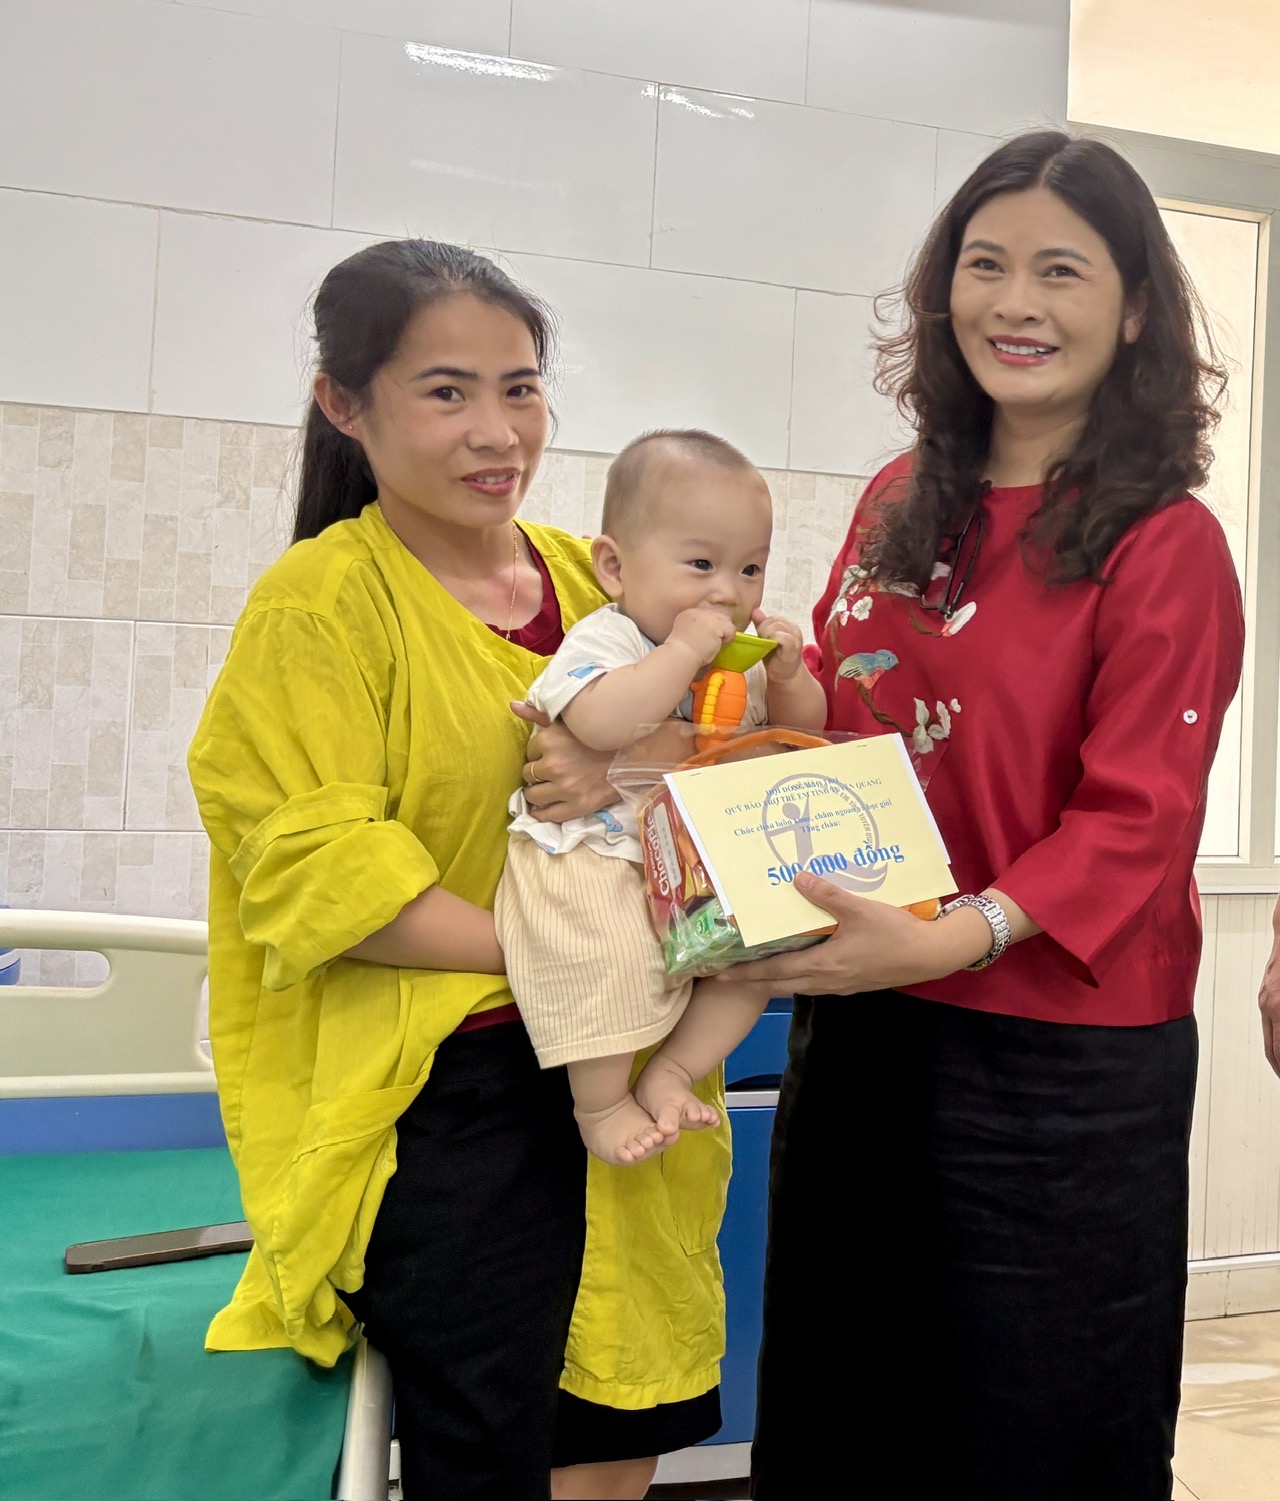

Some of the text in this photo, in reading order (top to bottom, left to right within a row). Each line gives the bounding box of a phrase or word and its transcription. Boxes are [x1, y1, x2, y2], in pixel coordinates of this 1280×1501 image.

[855, 778, 883, 790] QUANG
[734, 825, 755, 837] Chúc
[853, 840, 905, 867] đồng
